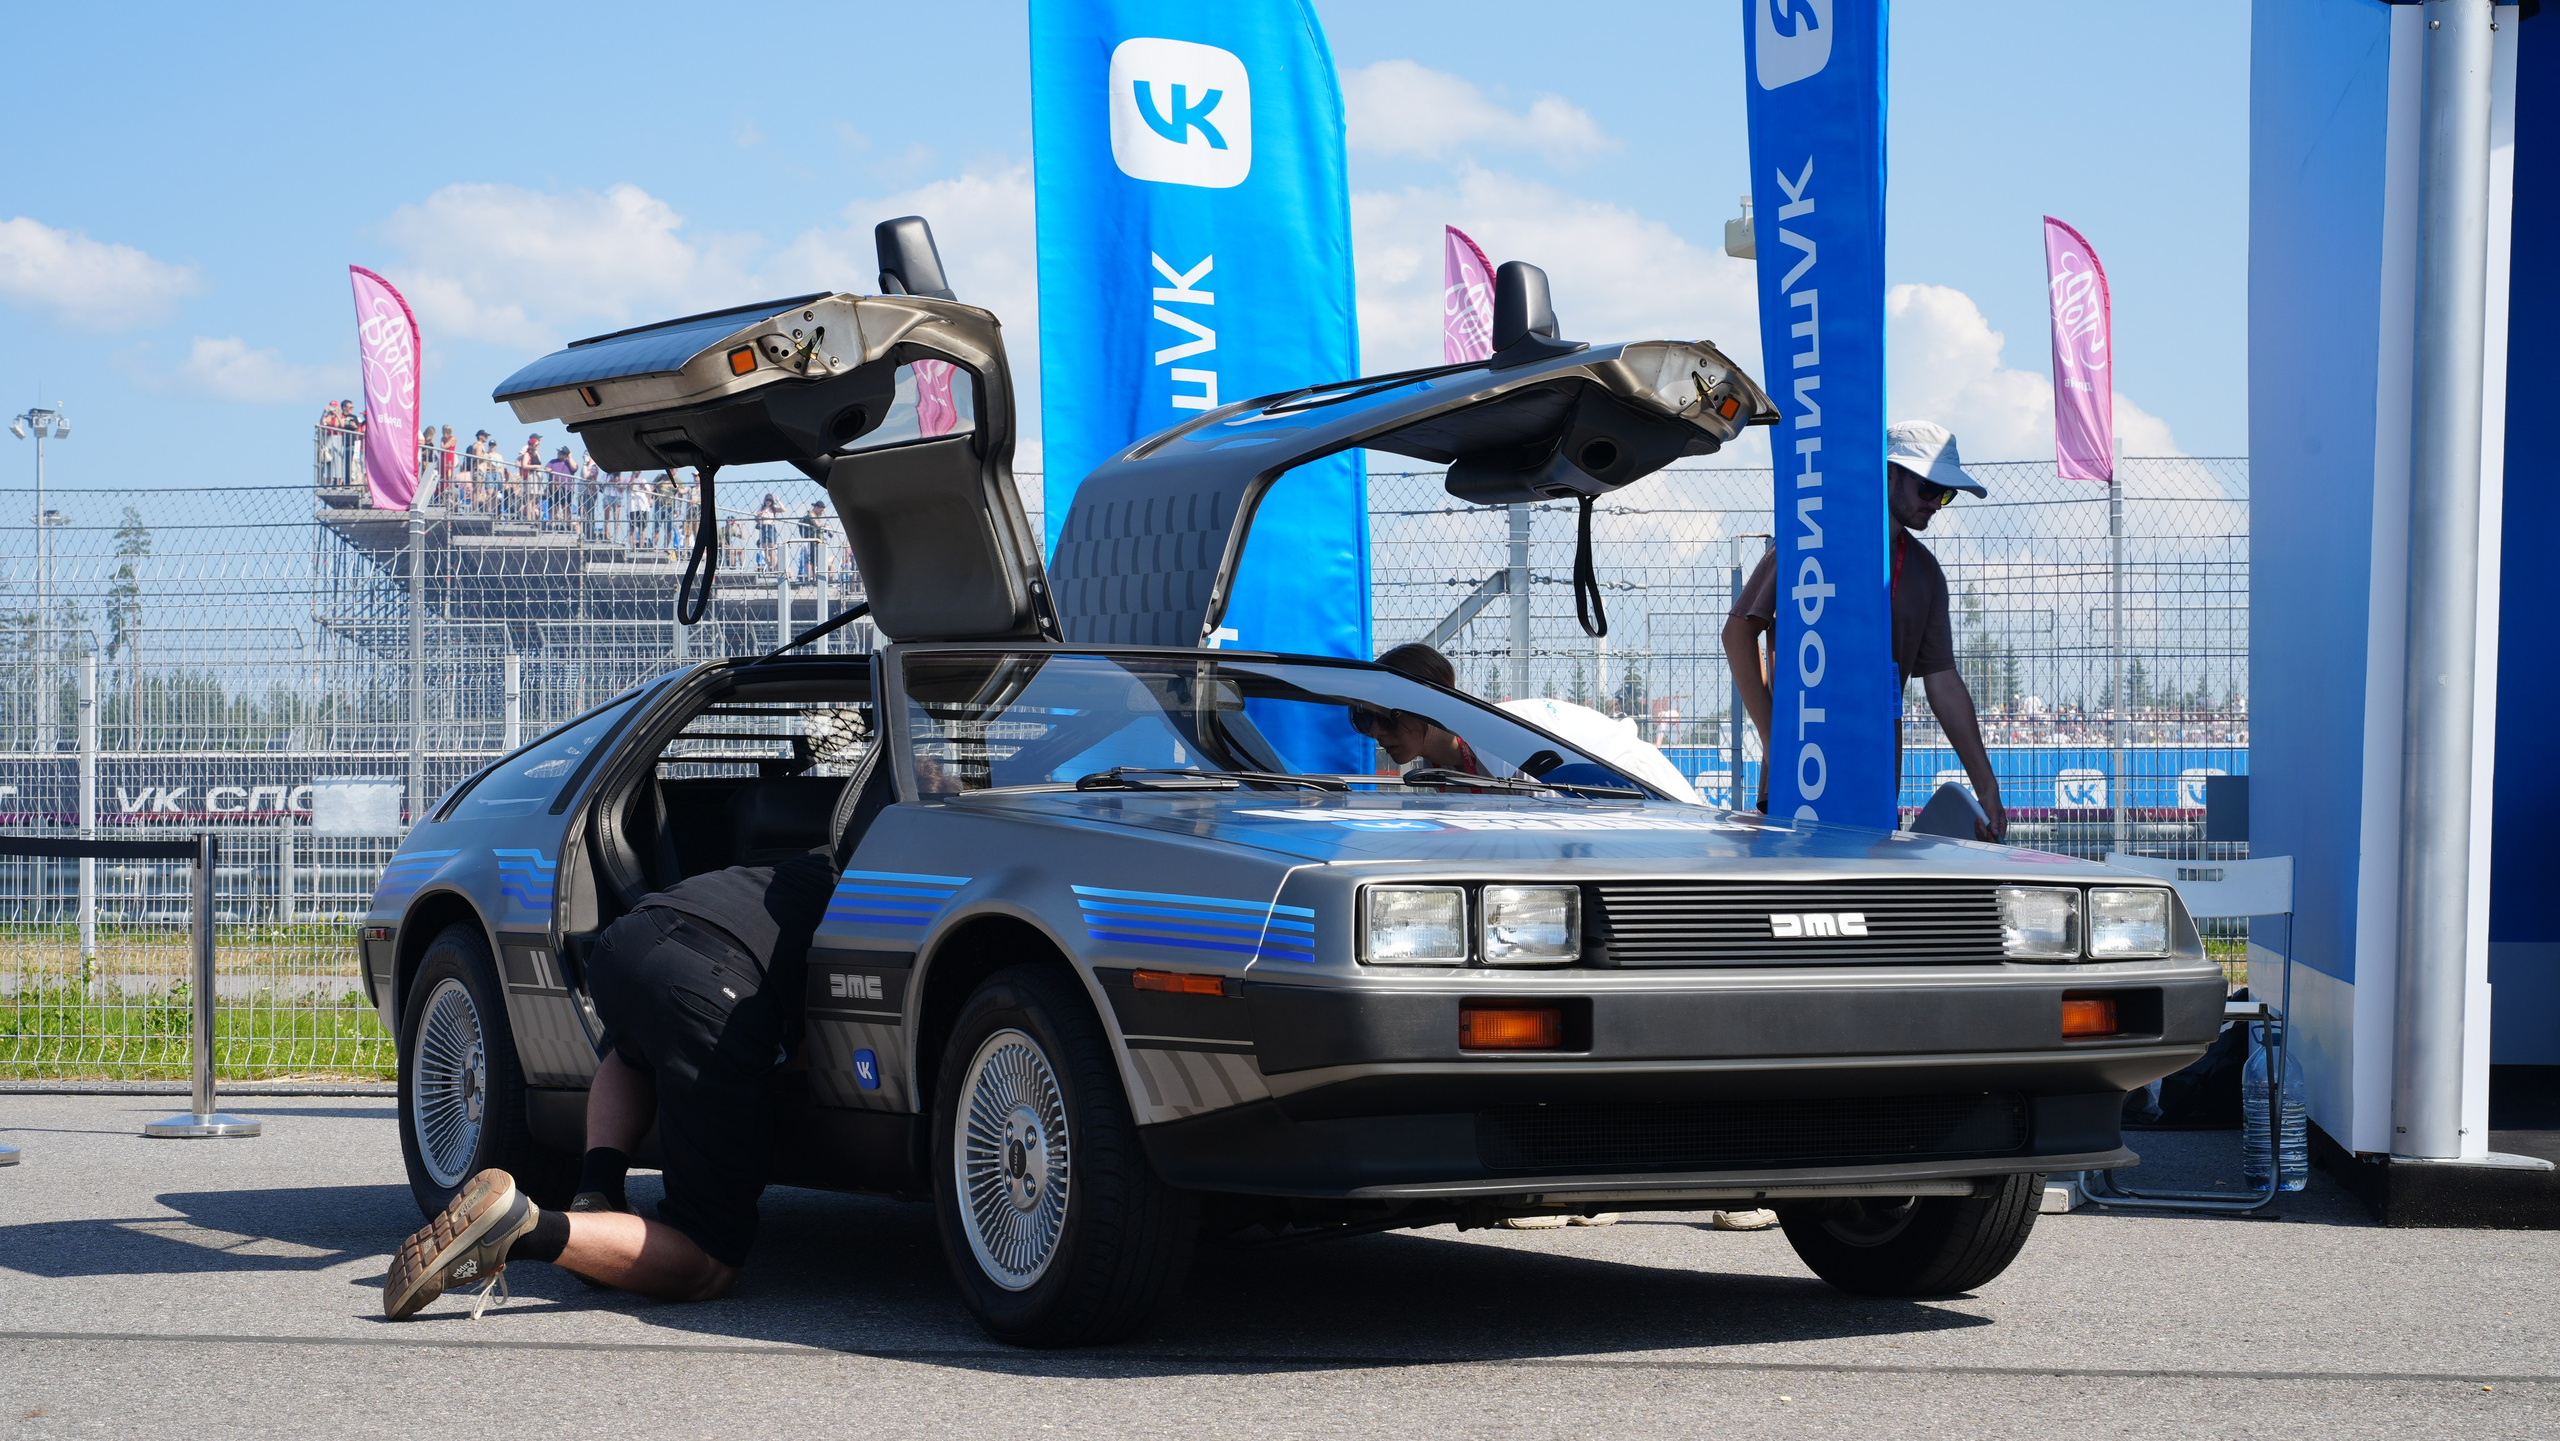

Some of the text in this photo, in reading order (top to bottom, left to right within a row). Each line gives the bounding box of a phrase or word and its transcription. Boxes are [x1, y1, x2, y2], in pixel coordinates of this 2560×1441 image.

[116, 786, 190, 812] VK
[2064, 784, 2098, 805] VK
[1769, 912, 1869, 938] DMC
[829, 973, 883, 1000] DMC
[856, 1061, 873, 1080] VK
